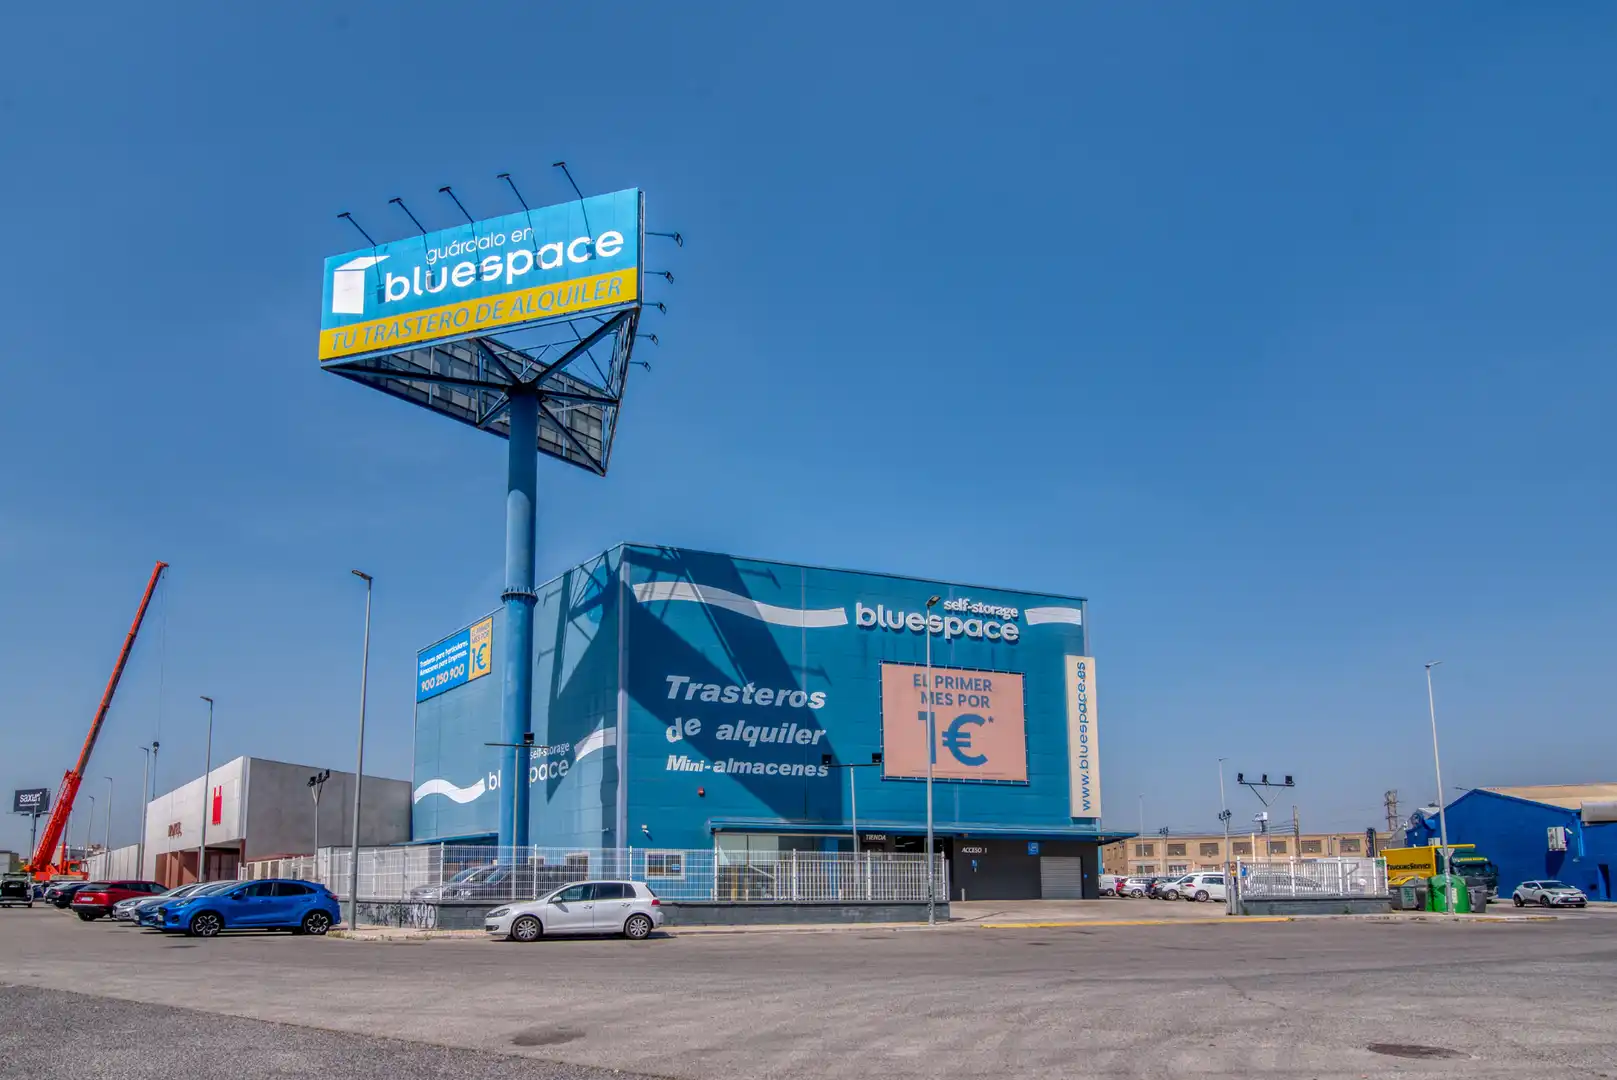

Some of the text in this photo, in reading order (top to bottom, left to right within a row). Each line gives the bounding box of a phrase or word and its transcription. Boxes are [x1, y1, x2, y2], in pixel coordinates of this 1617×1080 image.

[426, 231, 506, 265] guárdalo
[385, 230, 624, 302] bluespace
[332, 276, 623, 351] TU TRASTERO DE ALQUILER
[856, 602, 1019, 641] bluespace
[944, 598, 1019, 620] self-storage
[421, 677, 435, 693] 900
[450, 664, 464, 680] 900
[666, 675, 827, 709] Trasteros
[935, 675, 992, 692] PRIMER
[921, 691, 990, 709] MES POR
[666, 717, 827, 747] de alquiler
[1077, 661, 1091, 812] www.bluespace.es
[488, 759, 569, 790] blpace
[666, 754, 829, 777] Mini-almacenes
[961, 846, 982, 854] ACCESO
